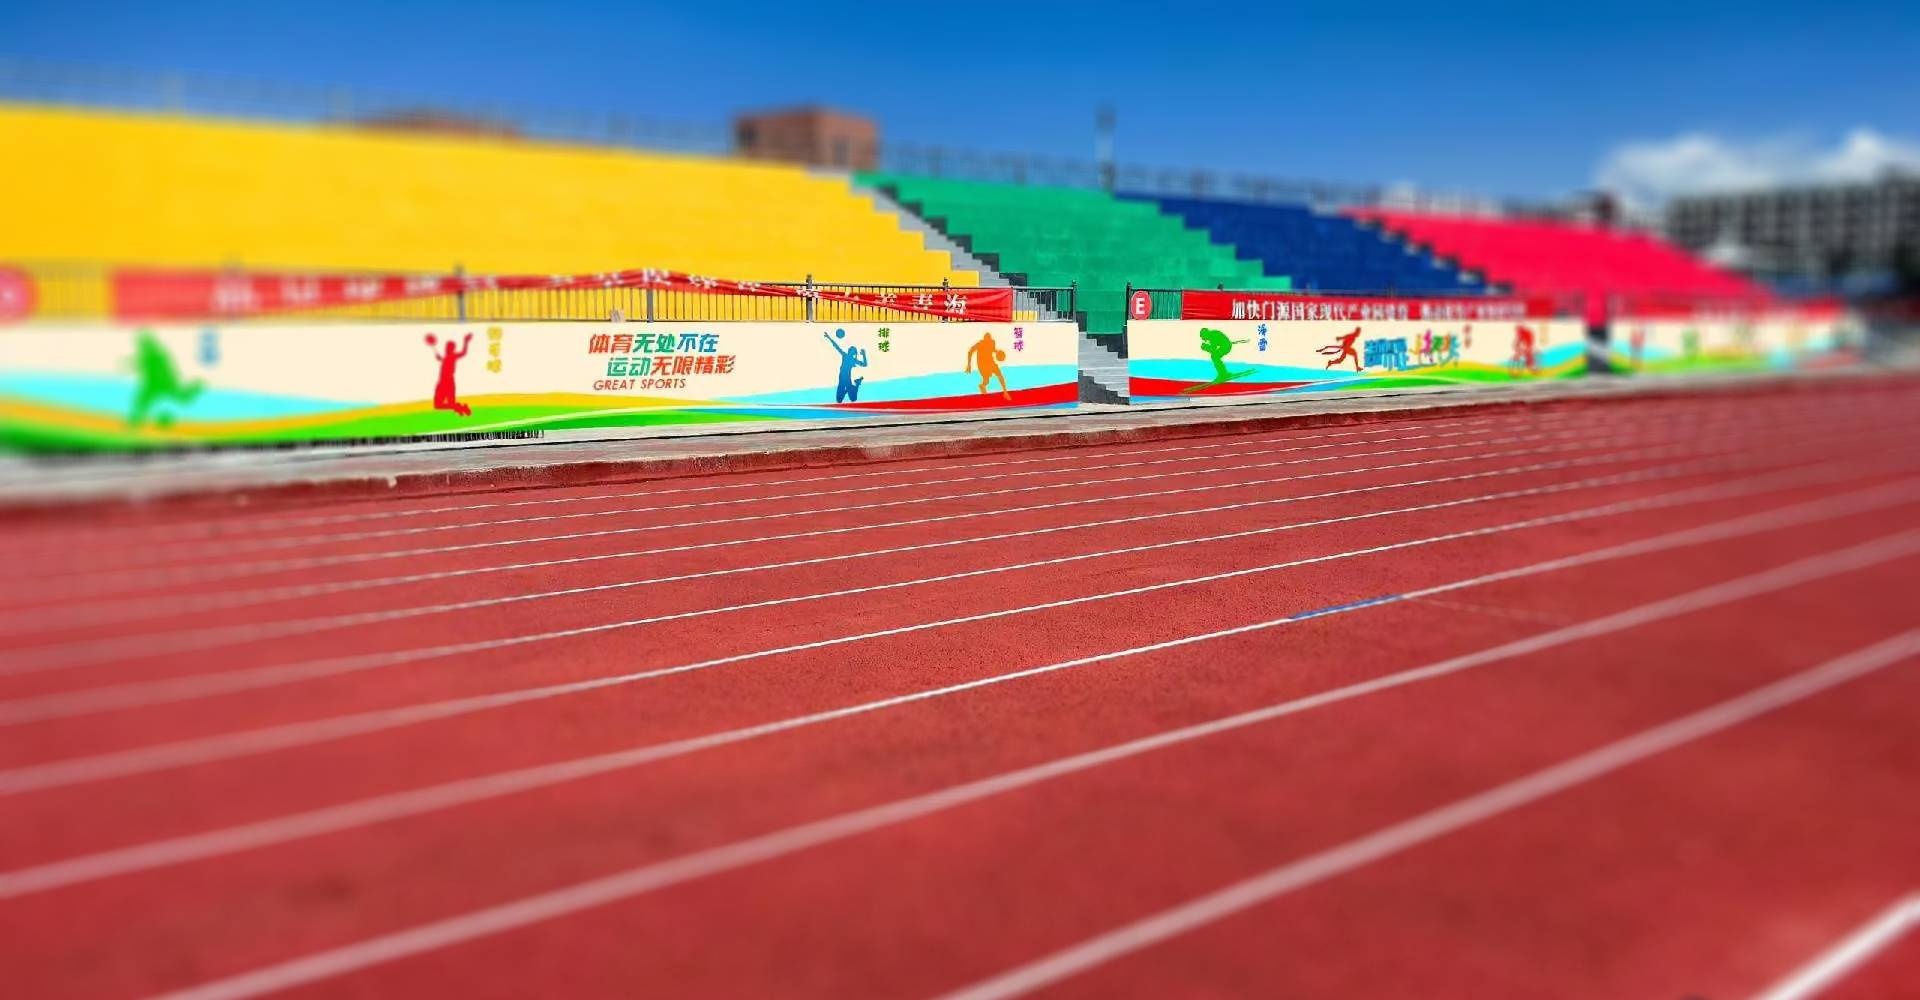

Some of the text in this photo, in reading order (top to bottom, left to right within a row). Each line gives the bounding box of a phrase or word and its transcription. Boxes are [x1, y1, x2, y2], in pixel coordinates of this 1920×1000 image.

[1134, 297, 1146, 316] E
[588, 333, 720, 354] 体育无处不在
[878, 327, 890, 352] 排球
[606, 355, 736, 377] 运动无限精彩
[592, 378, 687, 391] GREAT SPORTS
